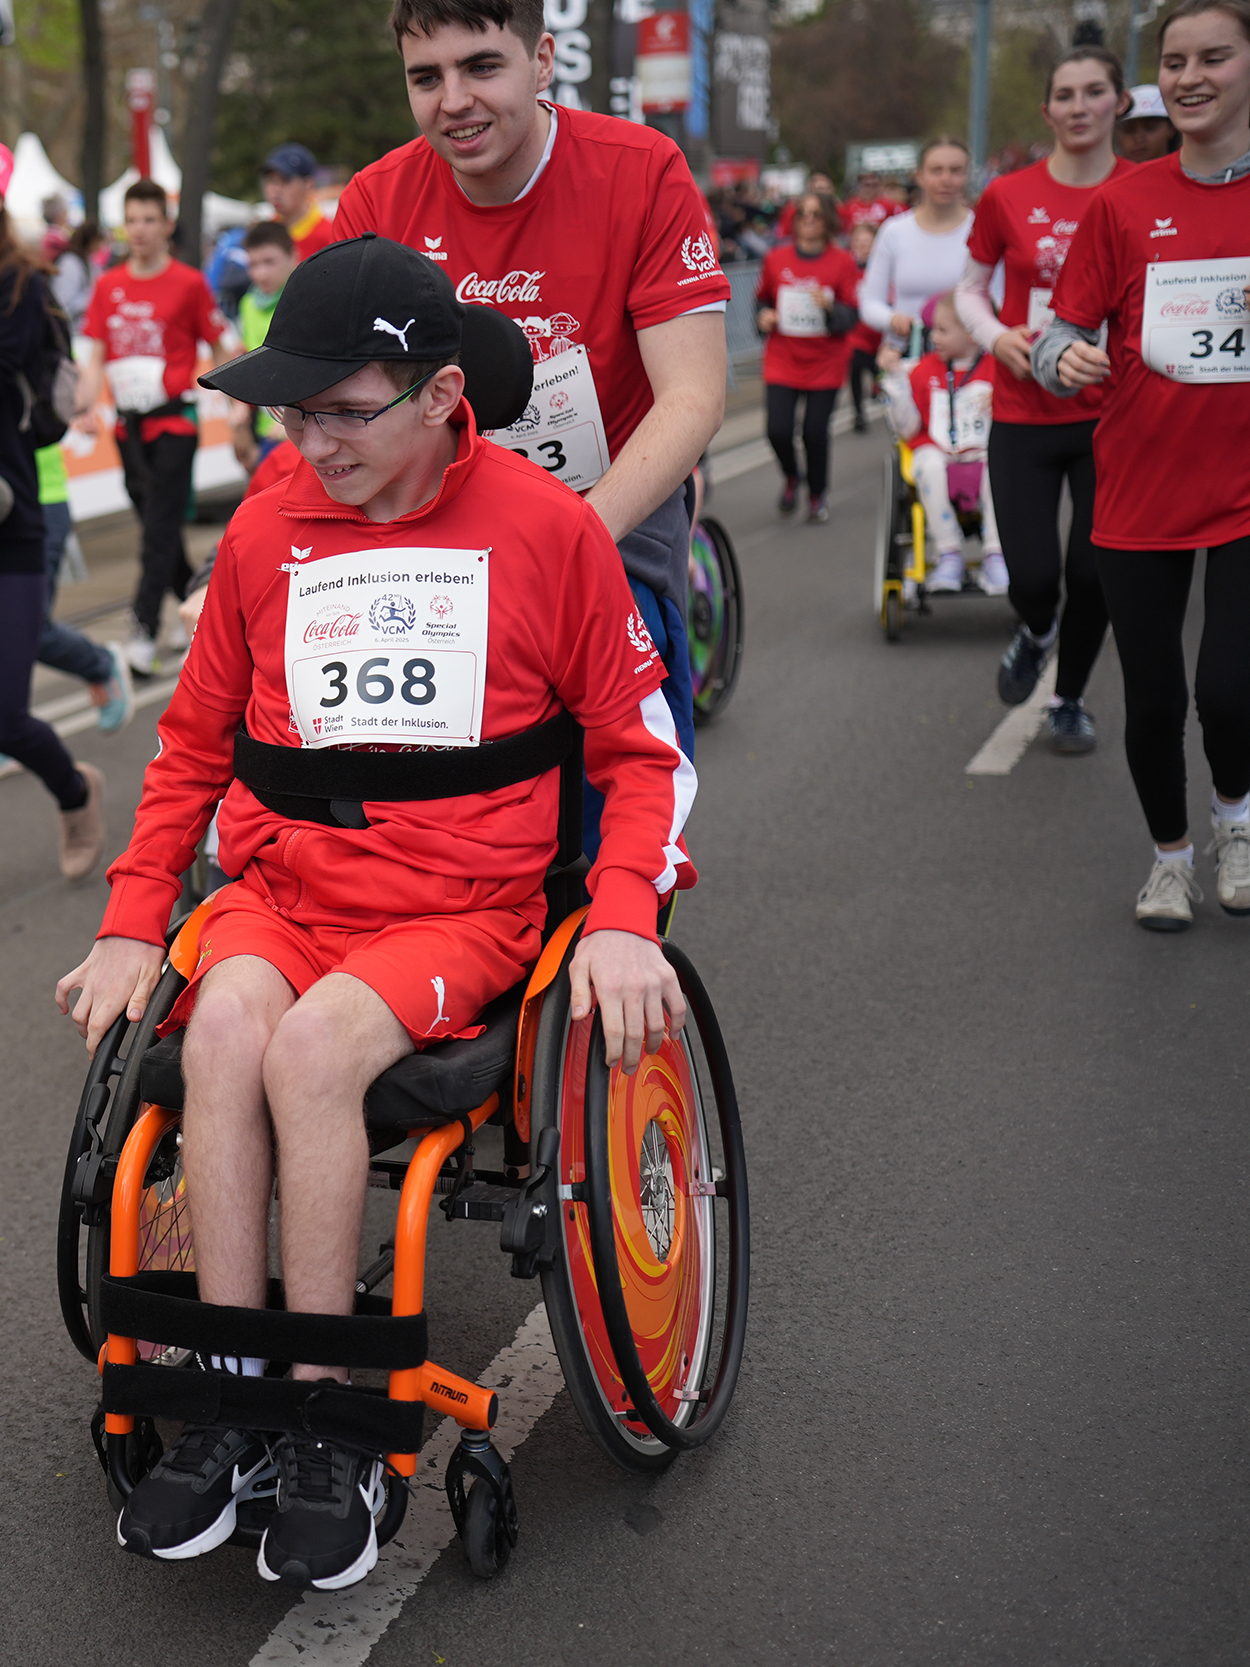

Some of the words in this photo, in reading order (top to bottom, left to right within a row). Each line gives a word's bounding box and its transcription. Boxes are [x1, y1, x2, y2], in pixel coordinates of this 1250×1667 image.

[677, 276, 700, 286] VIENNA
[1156, 275, 1197, 286] Laufend
[1200, 272, 1246, 283] Inklusion
[455, 270, 546, 304] Coca-Cola
[1160, 299, 1211, 318] Coca-Cola
[1200, 365, 1218, 374] Stadt
[534, 366, 580, 392] erleben!
[514, 424, 536, 432] VCM
[299, 577, 343, 597] Laufend
[348, 571, 410, 586] Inklusion
[415, 572, 474, 584] erleben!
[316, 603, 350, 617] MITEINAND
[303, 612, 365, 644] Coca-Cola
[382, 626, 405, 634] VCM
[422, 630, 460, 638] Olympics
[313, 639, 352, 651] ÖSTERREICH
[319, 657, 437, 708] 368
[324, 715, 343, 725] Stadt
[351, 717, 378, 727] Stadt
[381, 717, 398, 727] der
[401, 718, 448, 729] Inklusion.
[324, 724, 343, 733] Wien
